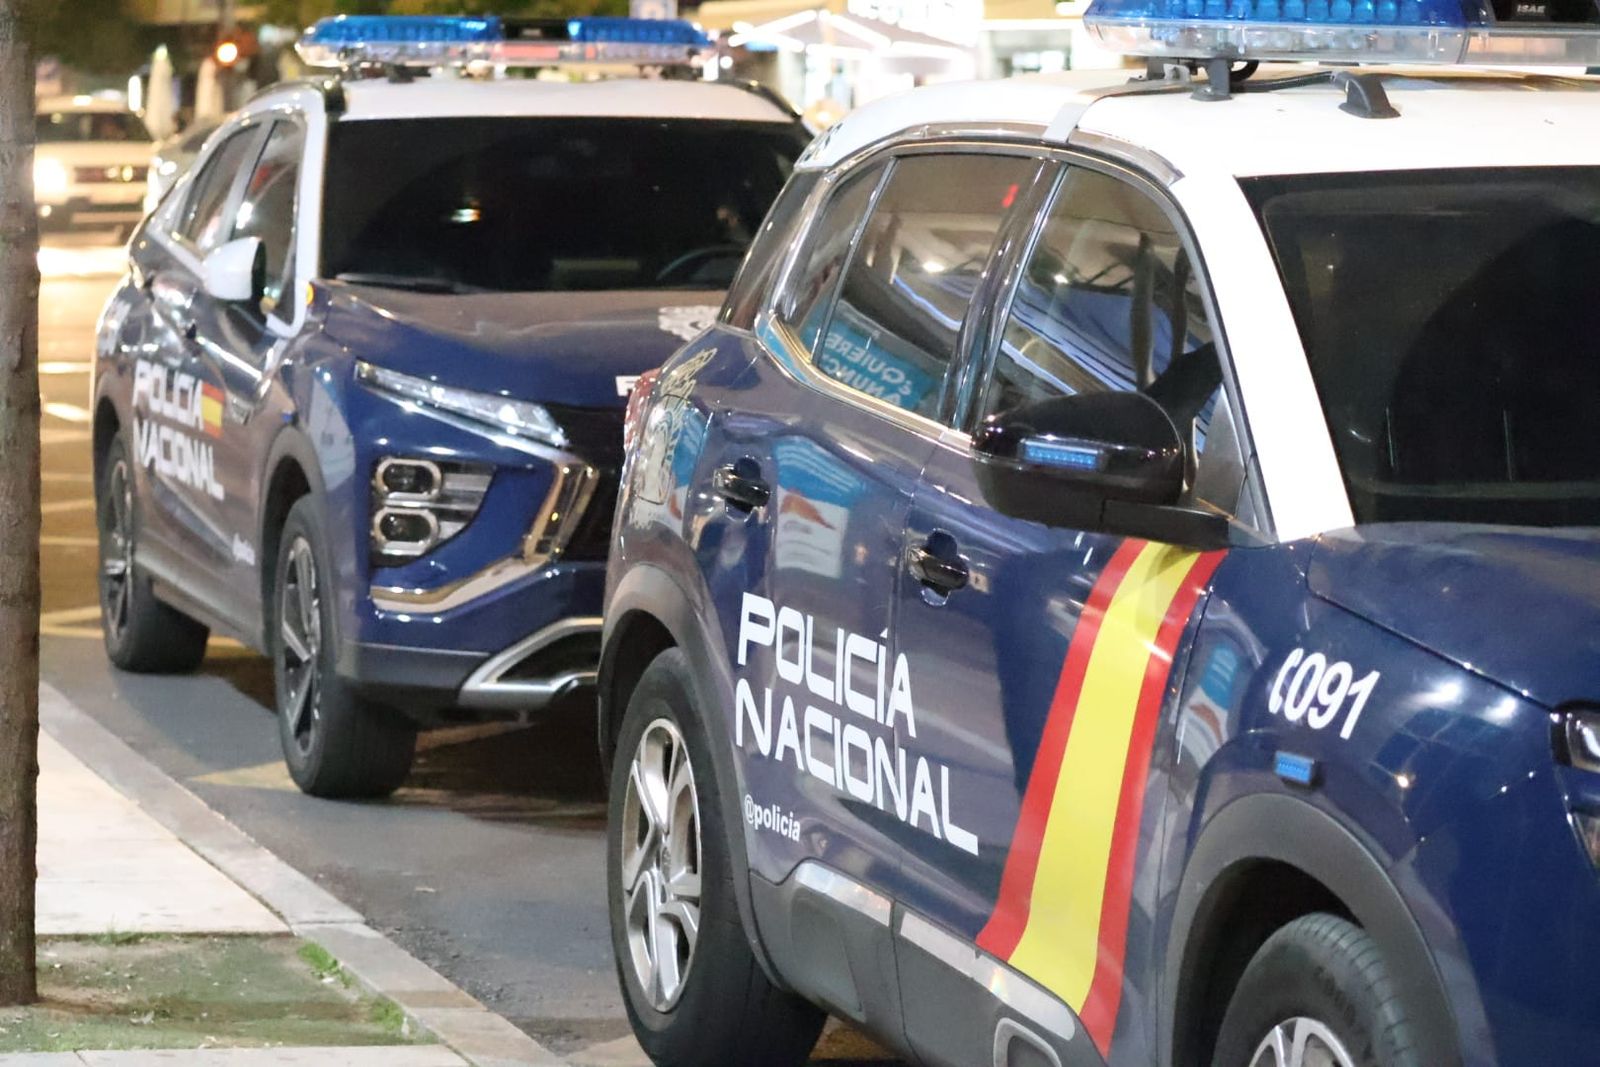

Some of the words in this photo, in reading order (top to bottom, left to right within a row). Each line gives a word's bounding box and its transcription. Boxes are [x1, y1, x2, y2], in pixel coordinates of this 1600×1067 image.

[132, 417, 224, 501] NACIONAL
[737, 591, 917, 739] POLICÍA
[735, 678, 979, 857] NACIONAL
[744, 793, 801, 842] @policia
